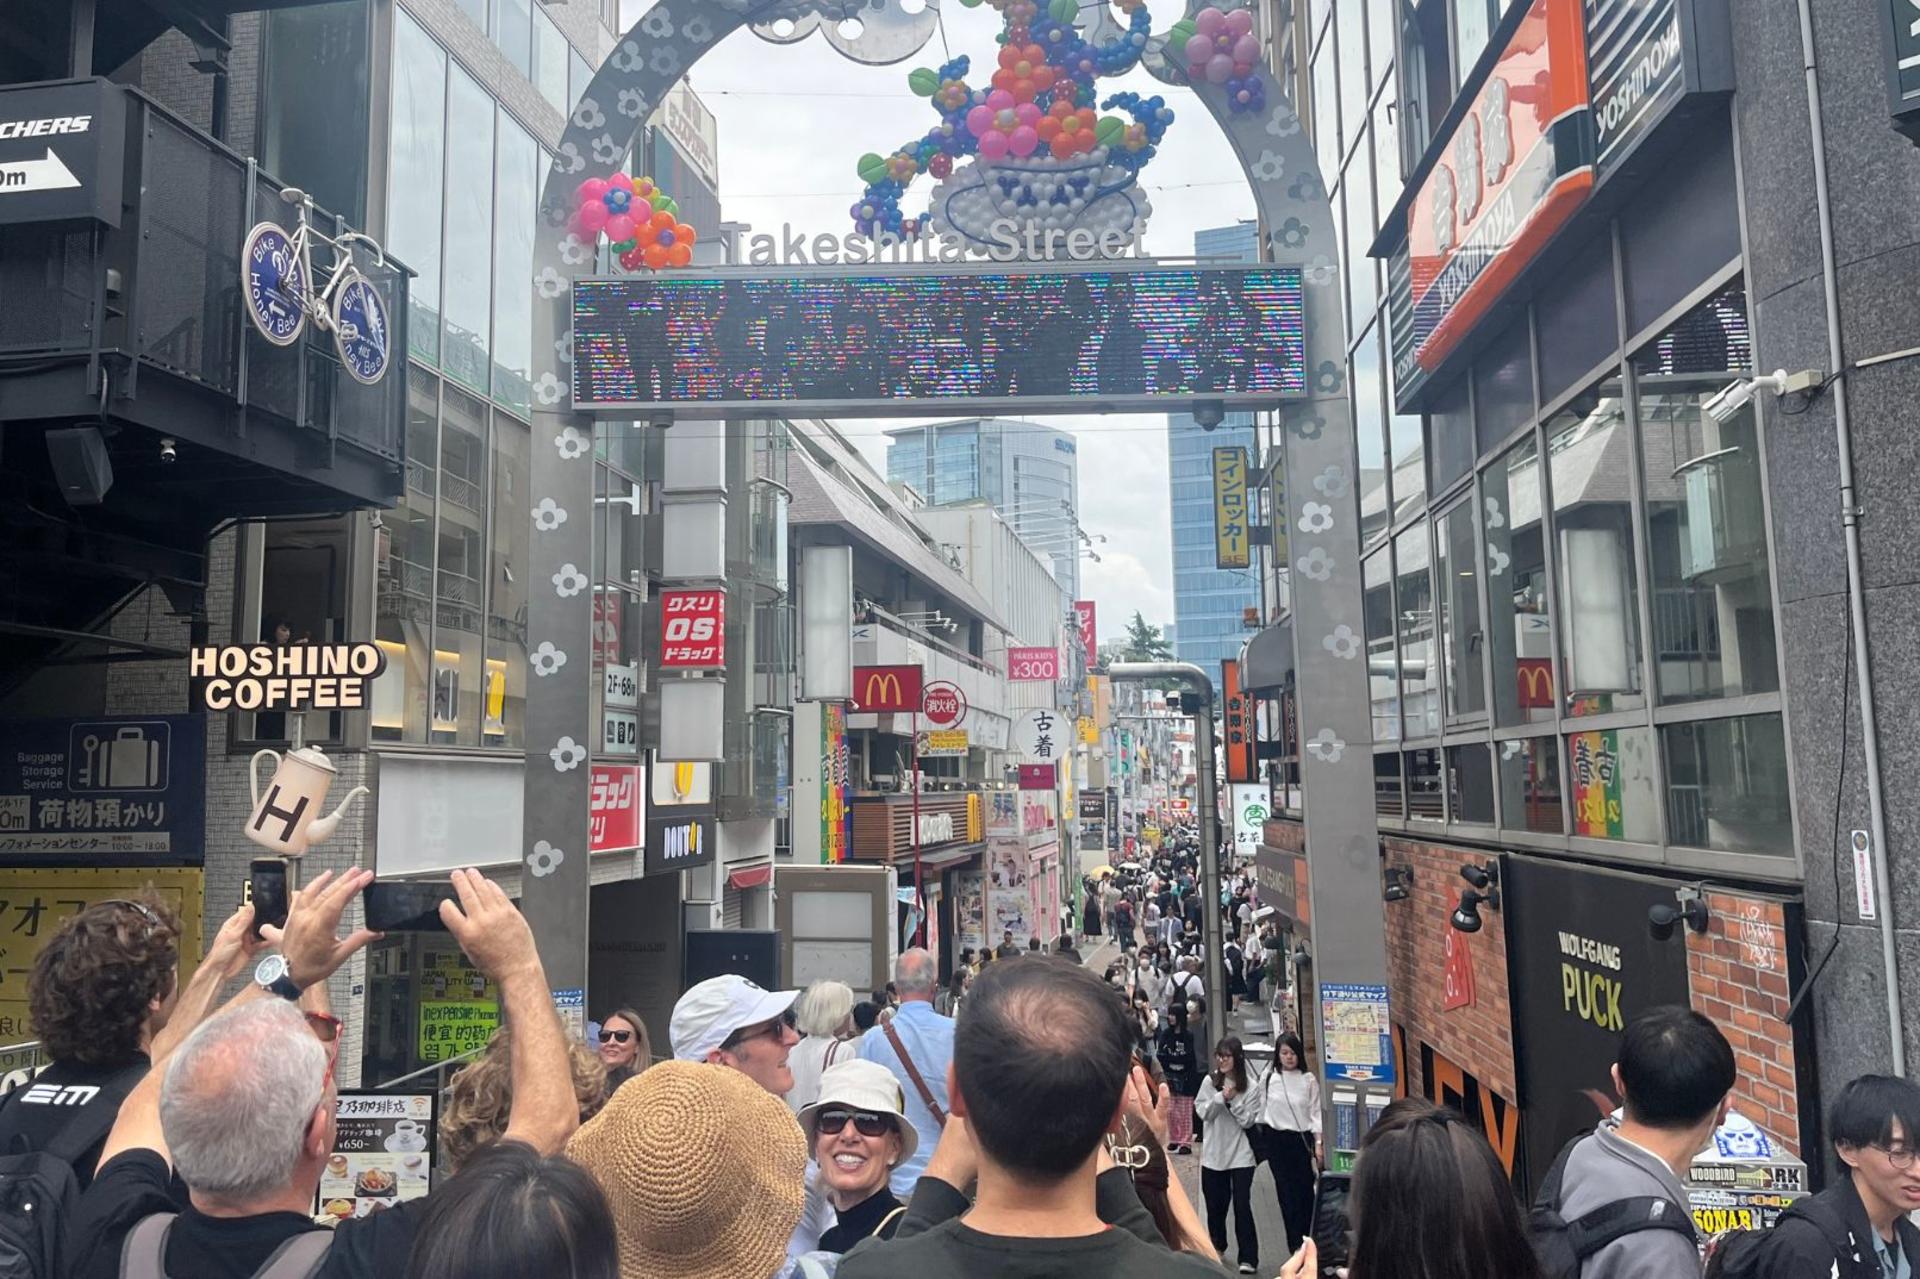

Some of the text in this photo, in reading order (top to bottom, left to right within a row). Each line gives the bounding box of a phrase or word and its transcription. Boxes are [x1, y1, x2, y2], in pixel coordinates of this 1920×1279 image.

[1595, 17, 1682, 143] YOSHINOYA
[253, 237, 275, 264] Bike
[720, 217, 1150, 265] Takeshita Street
[1438, 189, 1516, 318] YOSHINOYA
[250, 272, 296, 334] Honey Bee
[364, 355, 382, 374] Bee
[1219, 451, 1243, 552] コインロッカー
[667, 597, 715, 612] クスリ
[664, 618, 716, 642] OS
[190, 645, 379, 677] HOSHINO
[664, 647, 717, 661] ドラッグ
[1012, 661, 1054, 678] ¥300
[205, 678, 363, 709] COFFEE
[926, 698, 957, 714] 消火栓
[1032, 711, 1055, 758] 古着
[22, 766, 64, 777] Storage
[23, 779, 63, 791] Service
[38, 797, 166, 830] 荷物預かり
[253, 784, 309, 843] H
[663, 821, 703, 860] DOUTOR
[1558, 931, 1621, 972] WOLFGANG
[1562, 963, 1623, 1031] PUCK
[1690, 1168, 1735, 1181] WOODBIRD
[1693, 1208, 1753, 1234] SONAR
